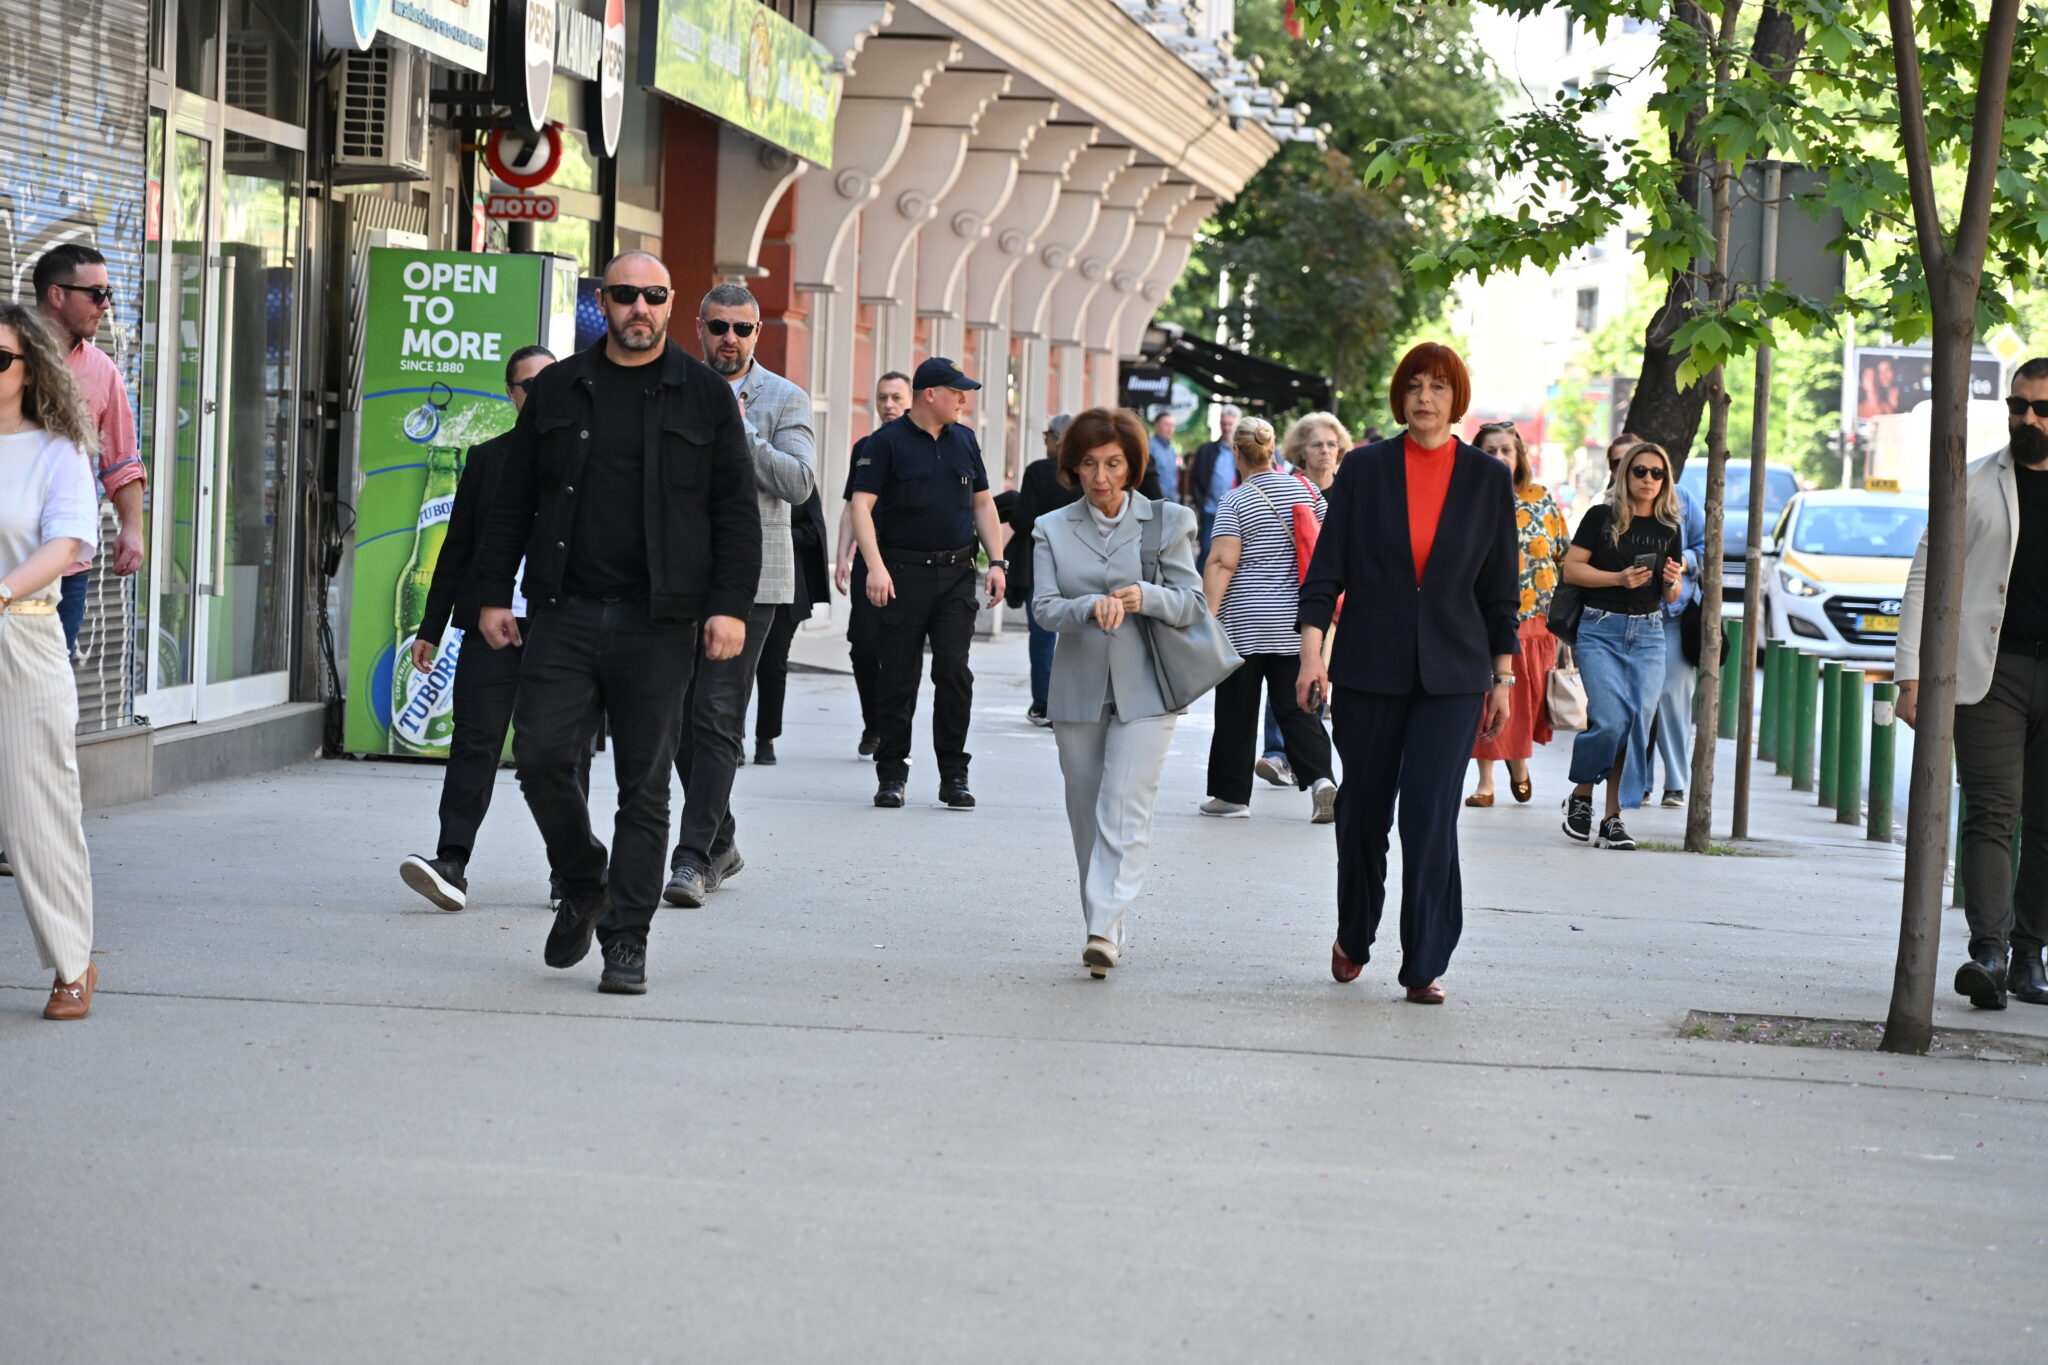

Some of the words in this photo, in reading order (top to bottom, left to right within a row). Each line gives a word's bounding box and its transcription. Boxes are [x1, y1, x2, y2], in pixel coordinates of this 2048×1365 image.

[528, 1, 554, 50] PEPSI
[604, 38, 624, 83] PEPSI
[489, 199, 553, 215] ЛОТО
[403, 261, 497, 294] OPEN
[402, 294, 454, 325] TO
[401, 328, 502, 361] MORE
[400, 359, 434, 372] SINCE
[436, 361, 464, 373] 1880
